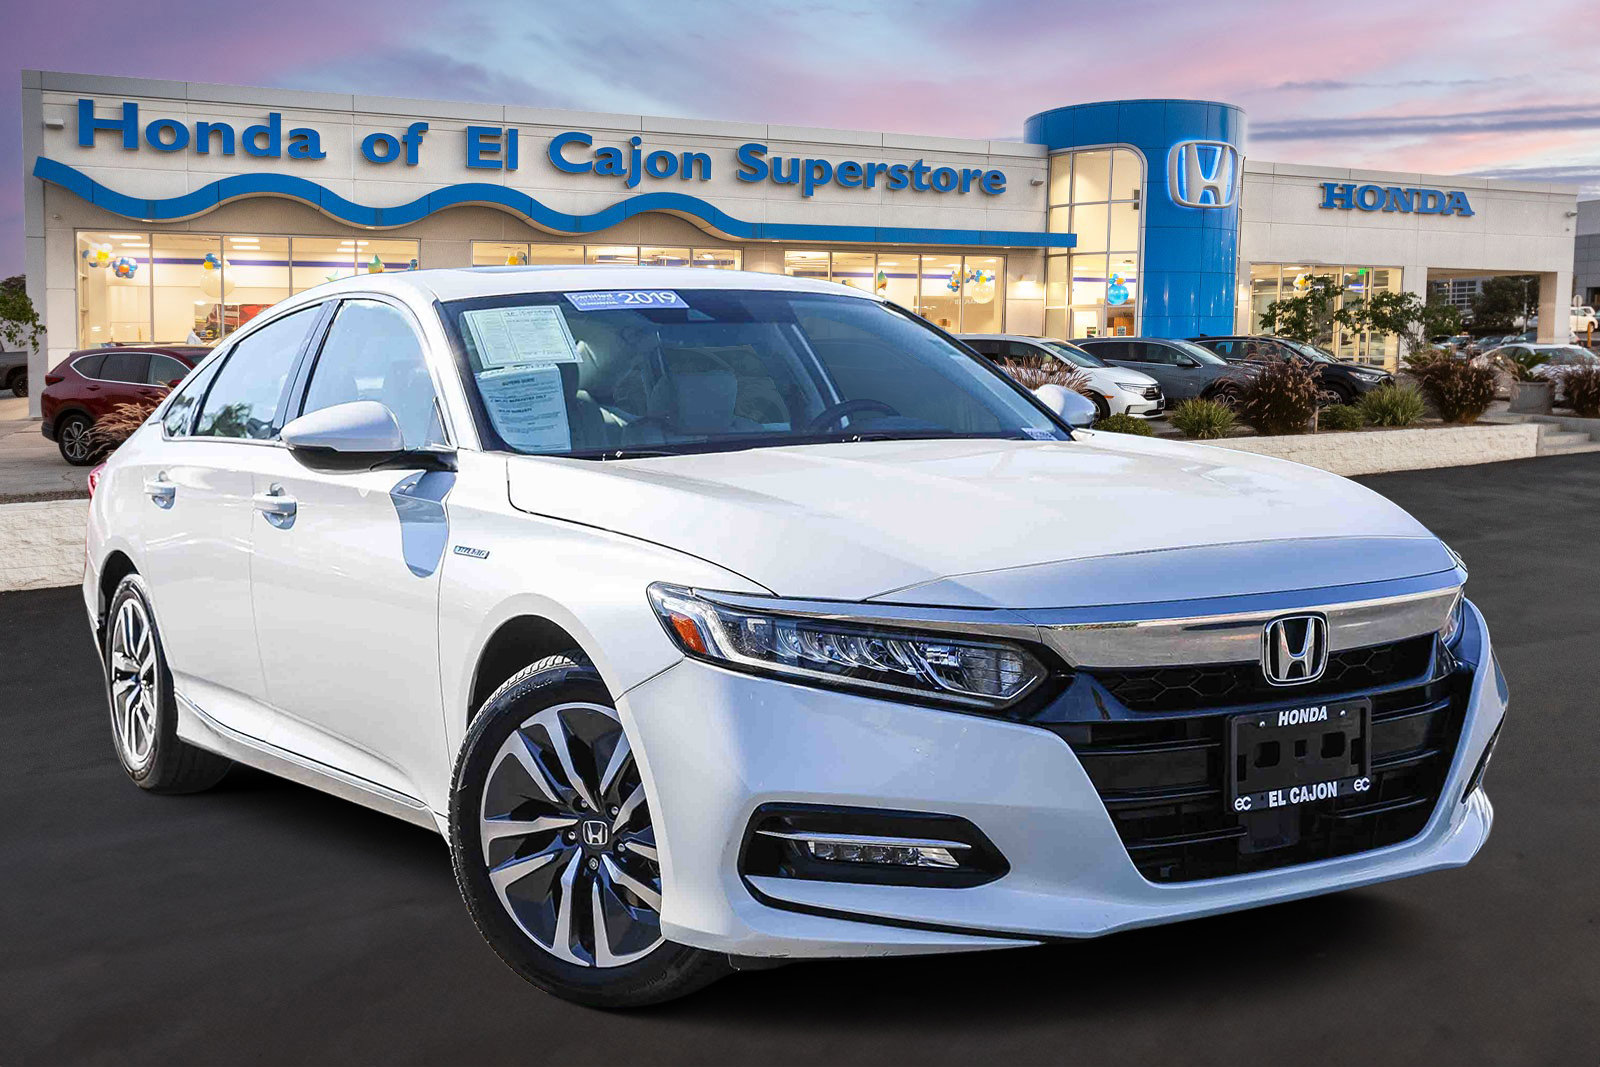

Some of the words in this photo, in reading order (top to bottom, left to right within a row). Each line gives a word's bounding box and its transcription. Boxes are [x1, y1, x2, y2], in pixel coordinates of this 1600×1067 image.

[77, 98, 327, 161] Honda
[360, 121, 429, 166] of
[465, 125, 519, 171] El
[547, 131, 713, 189] Cajon
[736, 142, 1008, 197] Superstore
[1319, 181, 1476, 218] HONDA
[618, 291, 678, 304] 2019
[1277, 705, 1329, 727] HONDA
[1268, 790, 1287, 808] EL
[1289, 780, 1338, 804] CAJON
